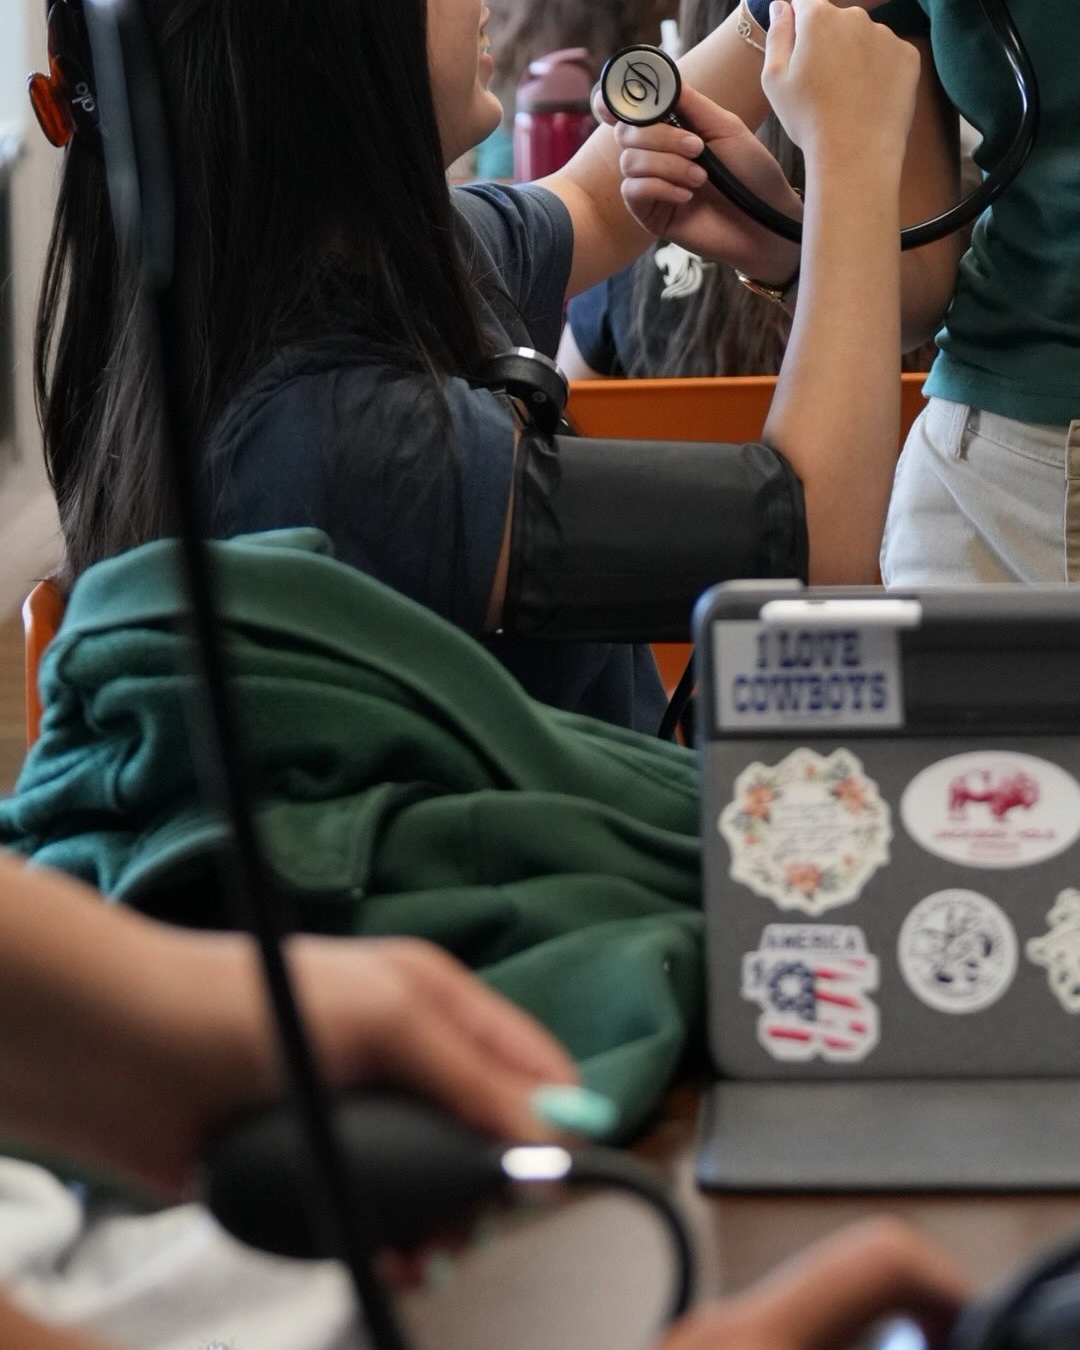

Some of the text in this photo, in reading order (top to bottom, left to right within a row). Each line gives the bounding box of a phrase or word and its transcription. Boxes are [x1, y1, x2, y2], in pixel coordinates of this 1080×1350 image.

[756, 627, 860, 669] I LOVE
[733, 672, 885, 714] COWBOYS
